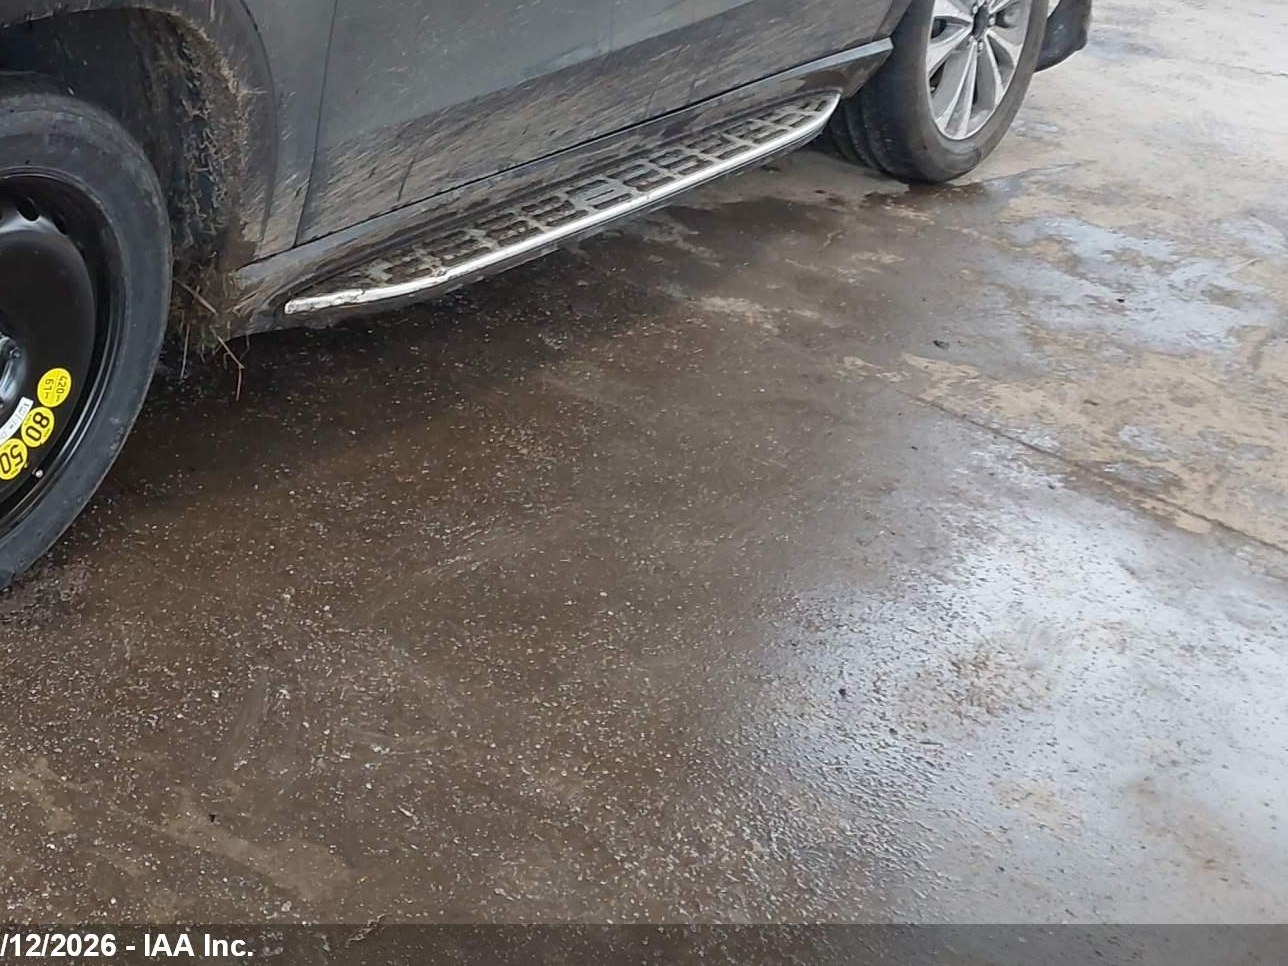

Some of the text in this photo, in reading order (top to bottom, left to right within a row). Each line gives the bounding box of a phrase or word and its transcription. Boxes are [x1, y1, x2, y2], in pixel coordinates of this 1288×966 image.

[55, 375, 68, 394] 420
[25, 412, 50, 442] 80
[0, 444, 24, 475] 50
